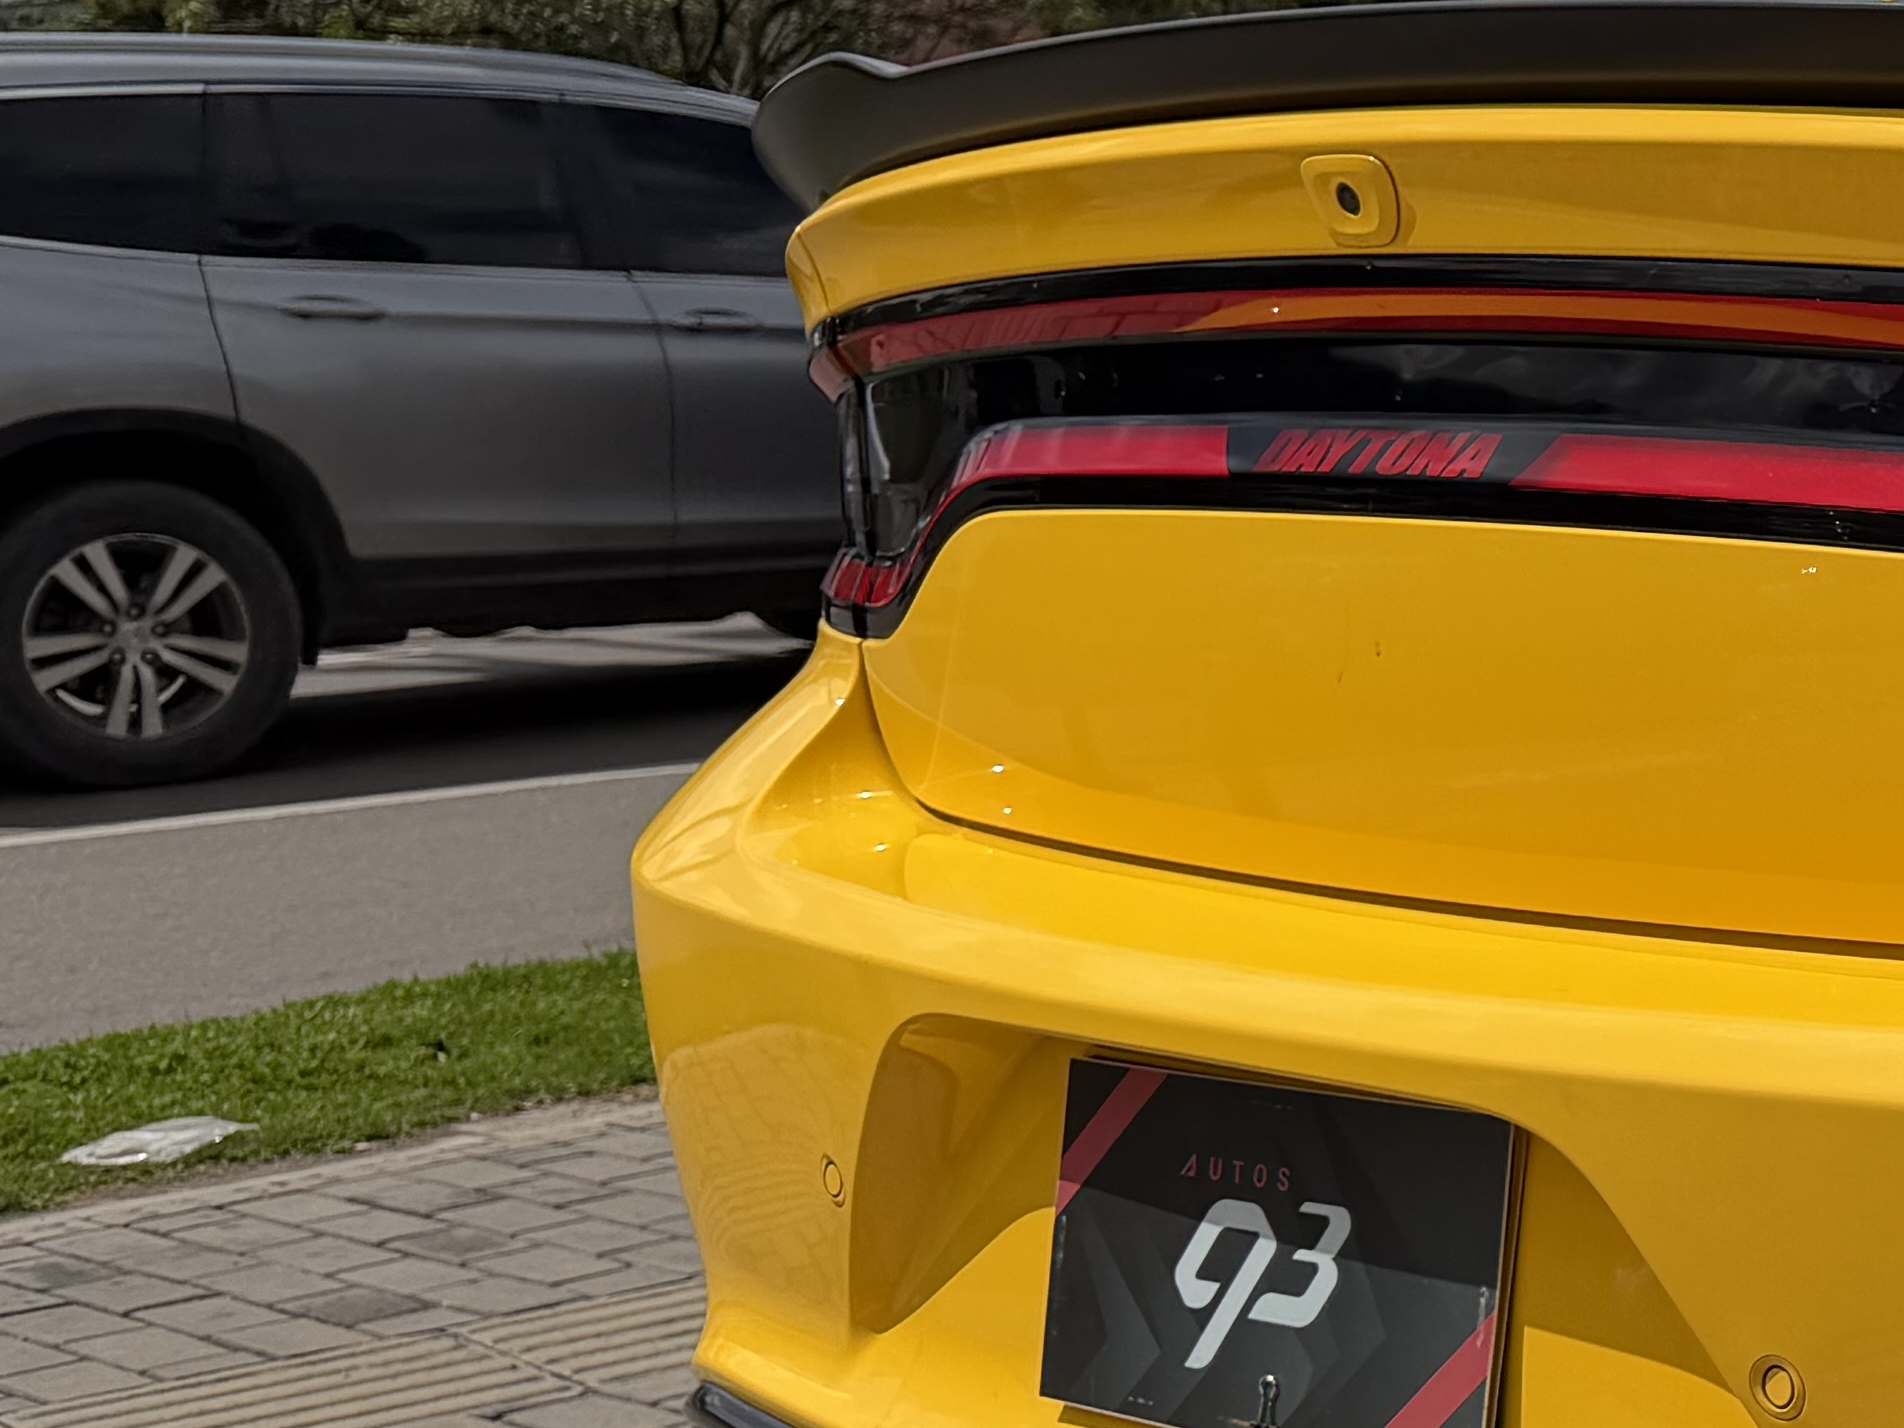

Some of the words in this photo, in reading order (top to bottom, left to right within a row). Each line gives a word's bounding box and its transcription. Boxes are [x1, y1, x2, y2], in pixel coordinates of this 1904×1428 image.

[1253, 429, 1503, 479] DAYTONA
[1180, 1153, 1291, 1192] AUTOS
[1174, 1198, 1352, 1370] 93
